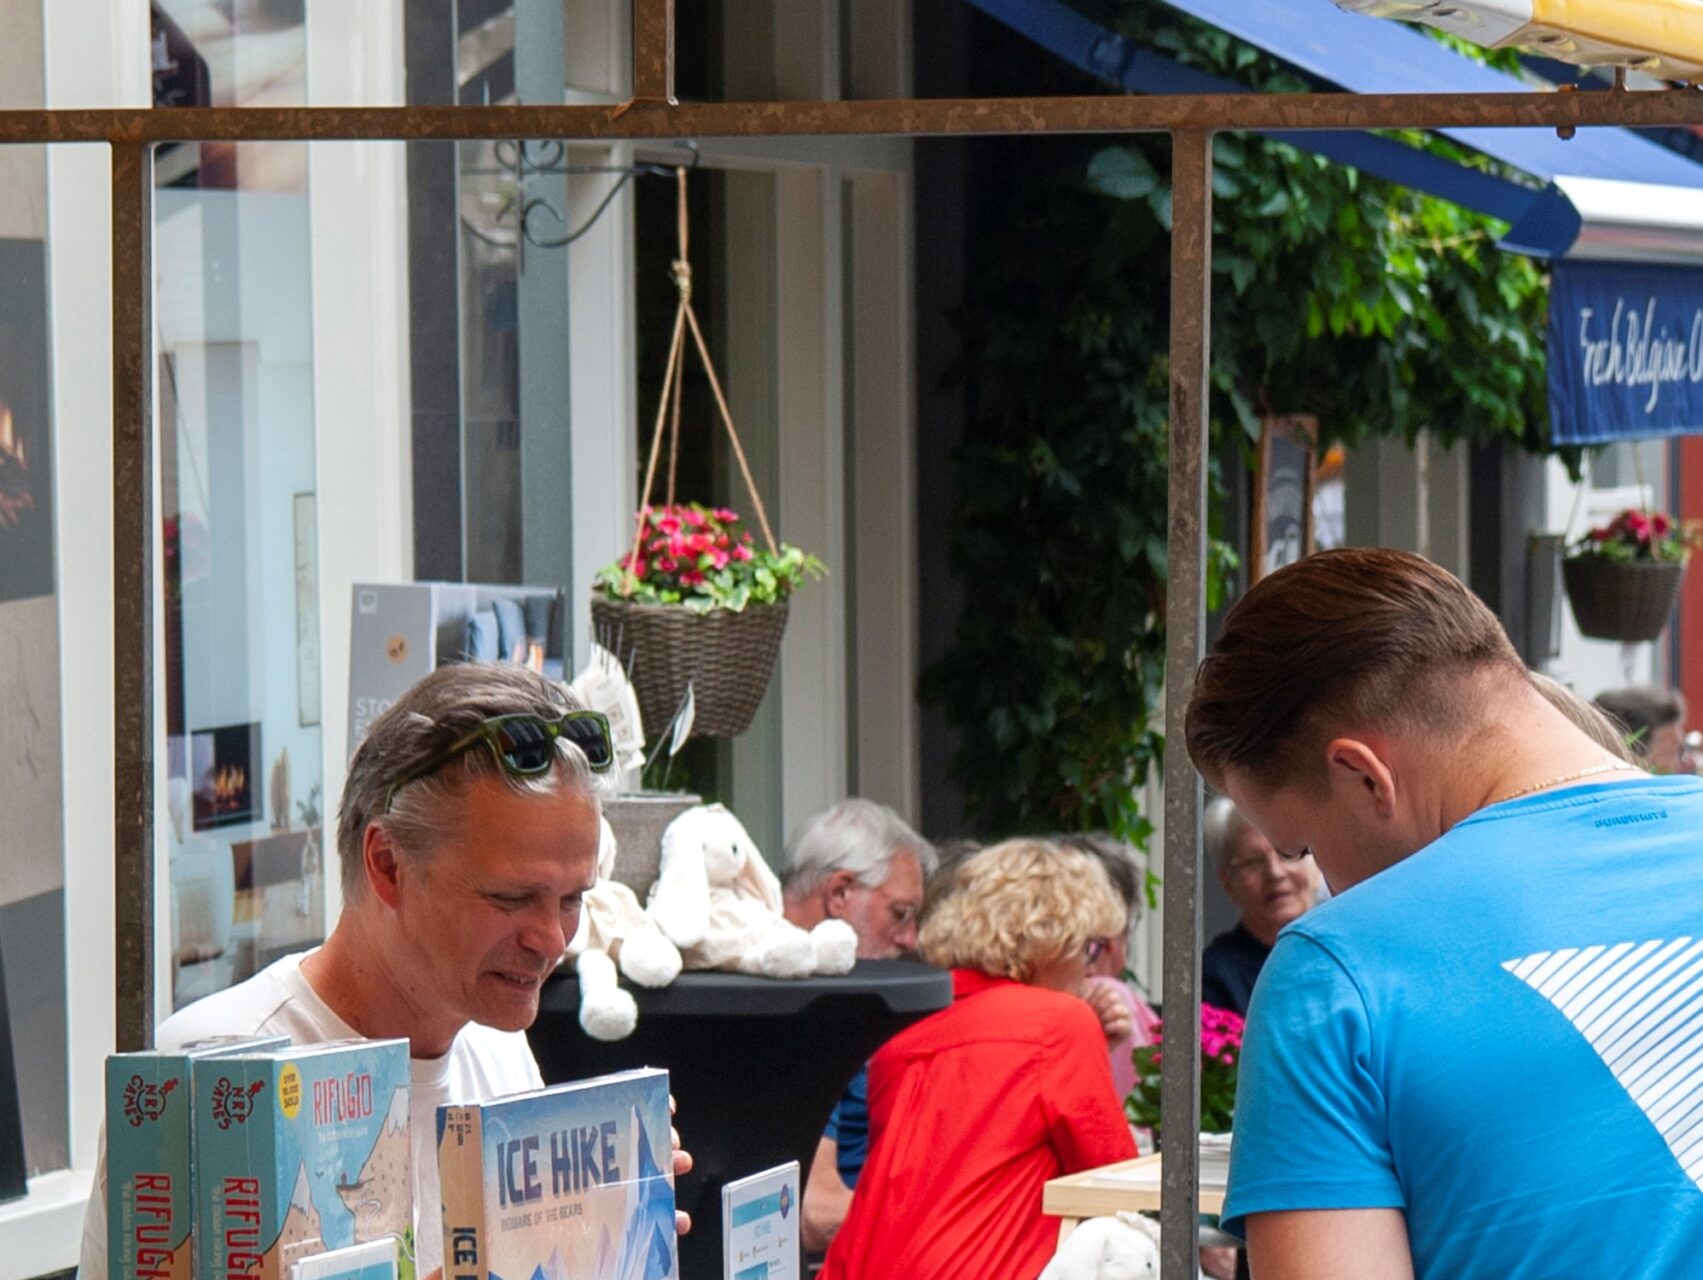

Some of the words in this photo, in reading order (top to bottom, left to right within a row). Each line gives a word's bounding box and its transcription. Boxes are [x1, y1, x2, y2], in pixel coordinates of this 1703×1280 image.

[124, 1075, 144, 1127] GAMES
[212, 1077, 232, 1130] GAMES
[314, 1072, 372, 1125] RIFUGIO
[497, 1135, 542, 1207] ICE
[550, 1120, 620, 1197] HIKE
[560, 1203, 583, 1219] BEARS
[453, 1227, 477, 1266] ICE
